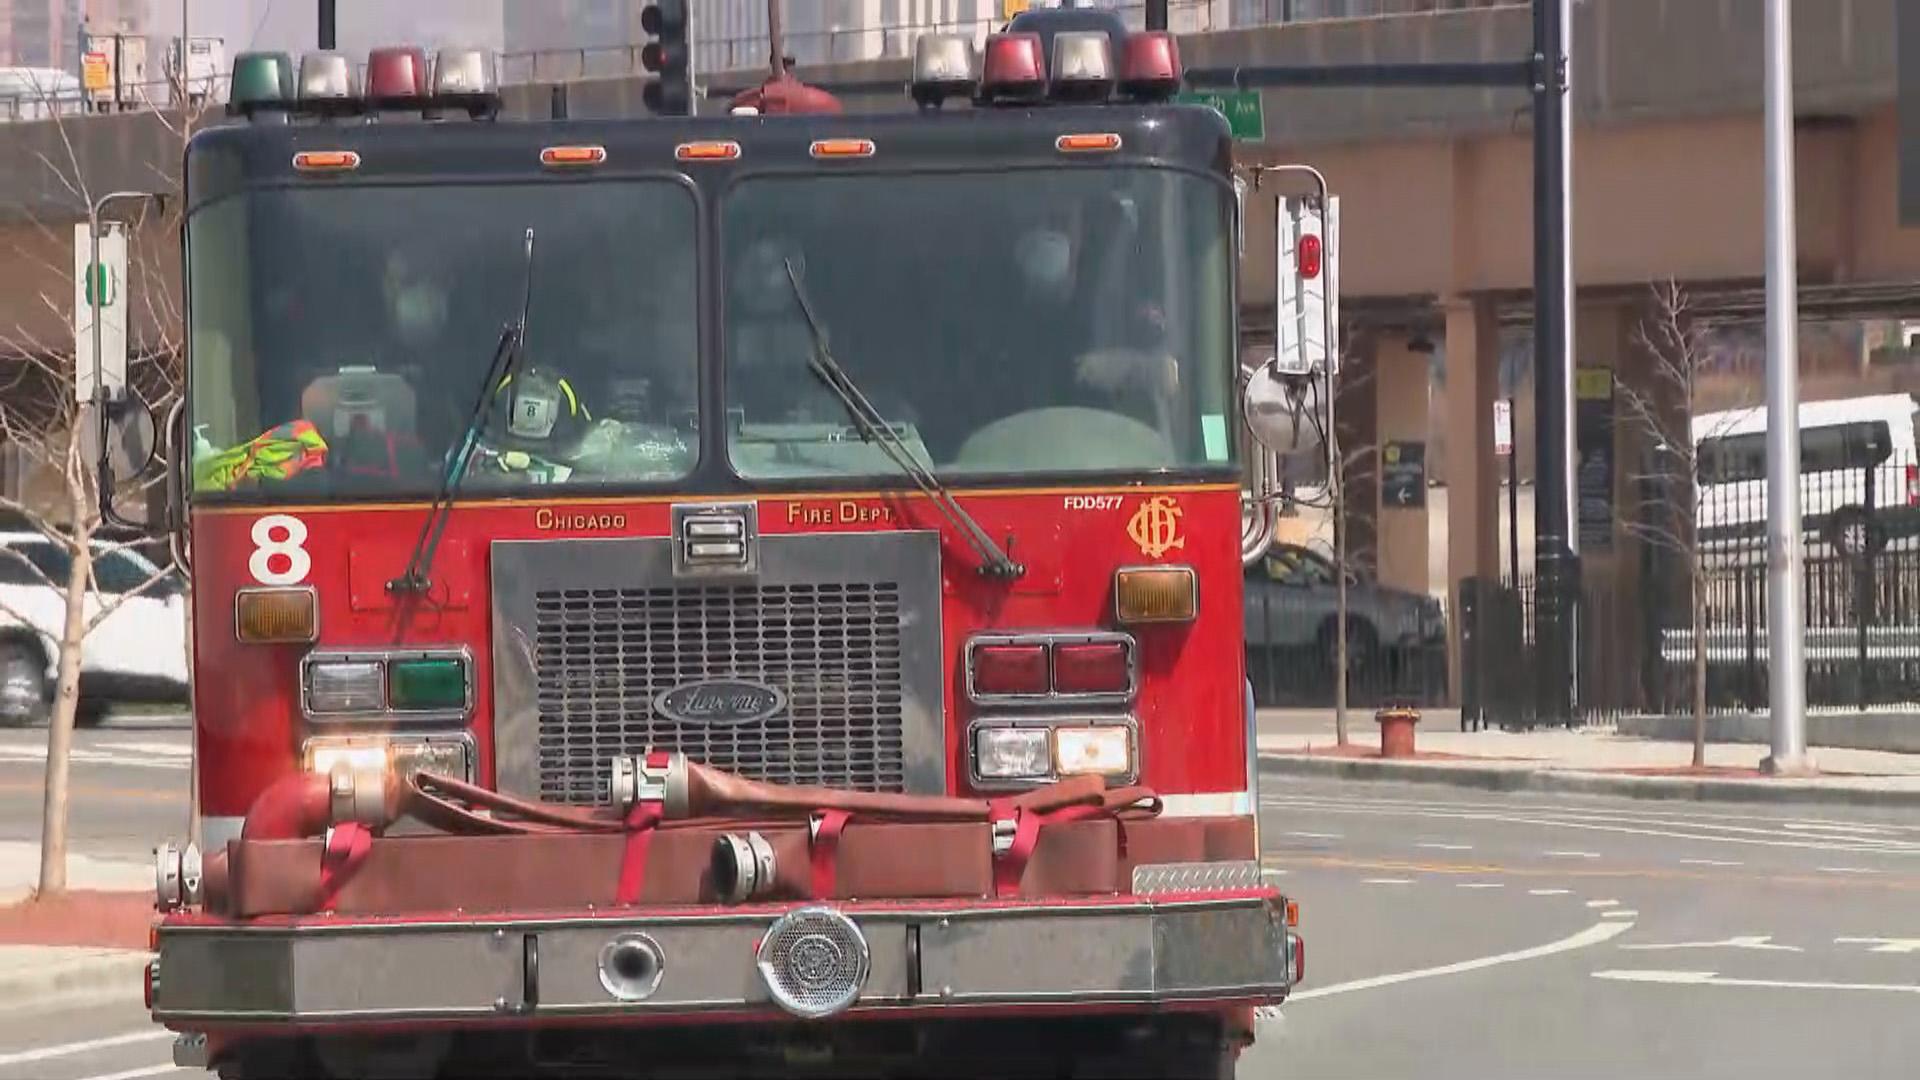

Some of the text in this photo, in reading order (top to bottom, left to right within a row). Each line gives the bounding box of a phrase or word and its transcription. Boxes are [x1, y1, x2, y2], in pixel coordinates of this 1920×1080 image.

[526, 405, 537, 417] 8
[1063, 495, 1123, 510] FDD577
[248, 514, 312, 585] 8
